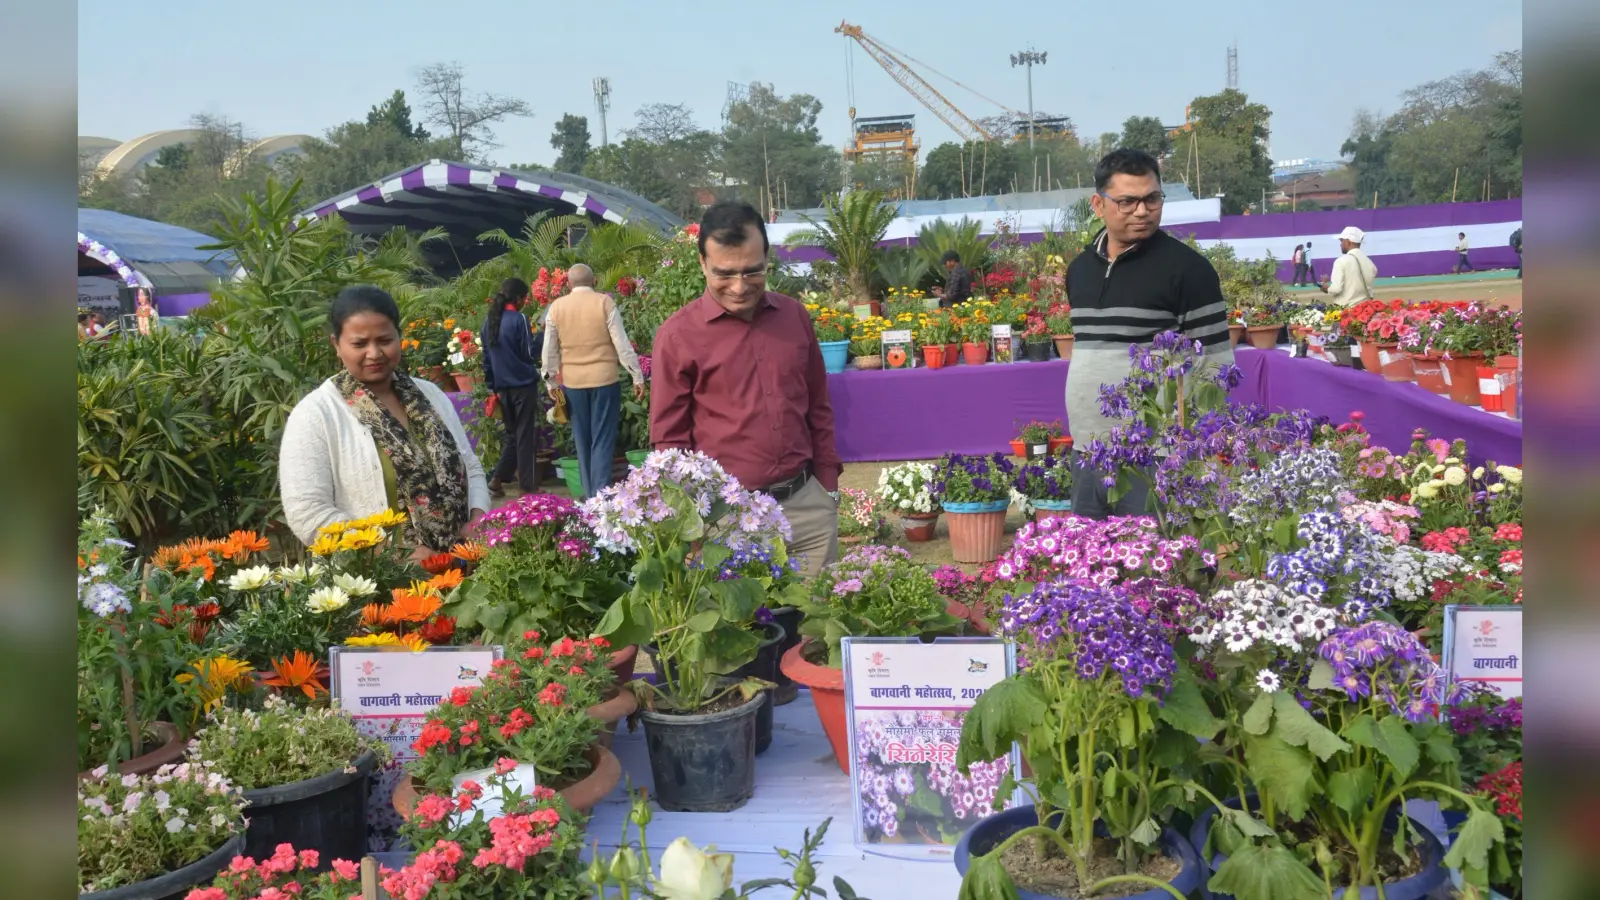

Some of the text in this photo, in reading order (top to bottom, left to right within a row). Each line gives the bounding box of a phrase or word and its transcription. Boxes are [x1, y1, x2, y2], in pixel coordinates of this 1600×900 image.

[1473, 655, 1519, 669] बागवानी
[359, 693, 401, 707] बागवानी
[870, 684, 987, 701] बागवानी महोत्सव, 202
[887, 742, 957, 763] सिनेरेरि
